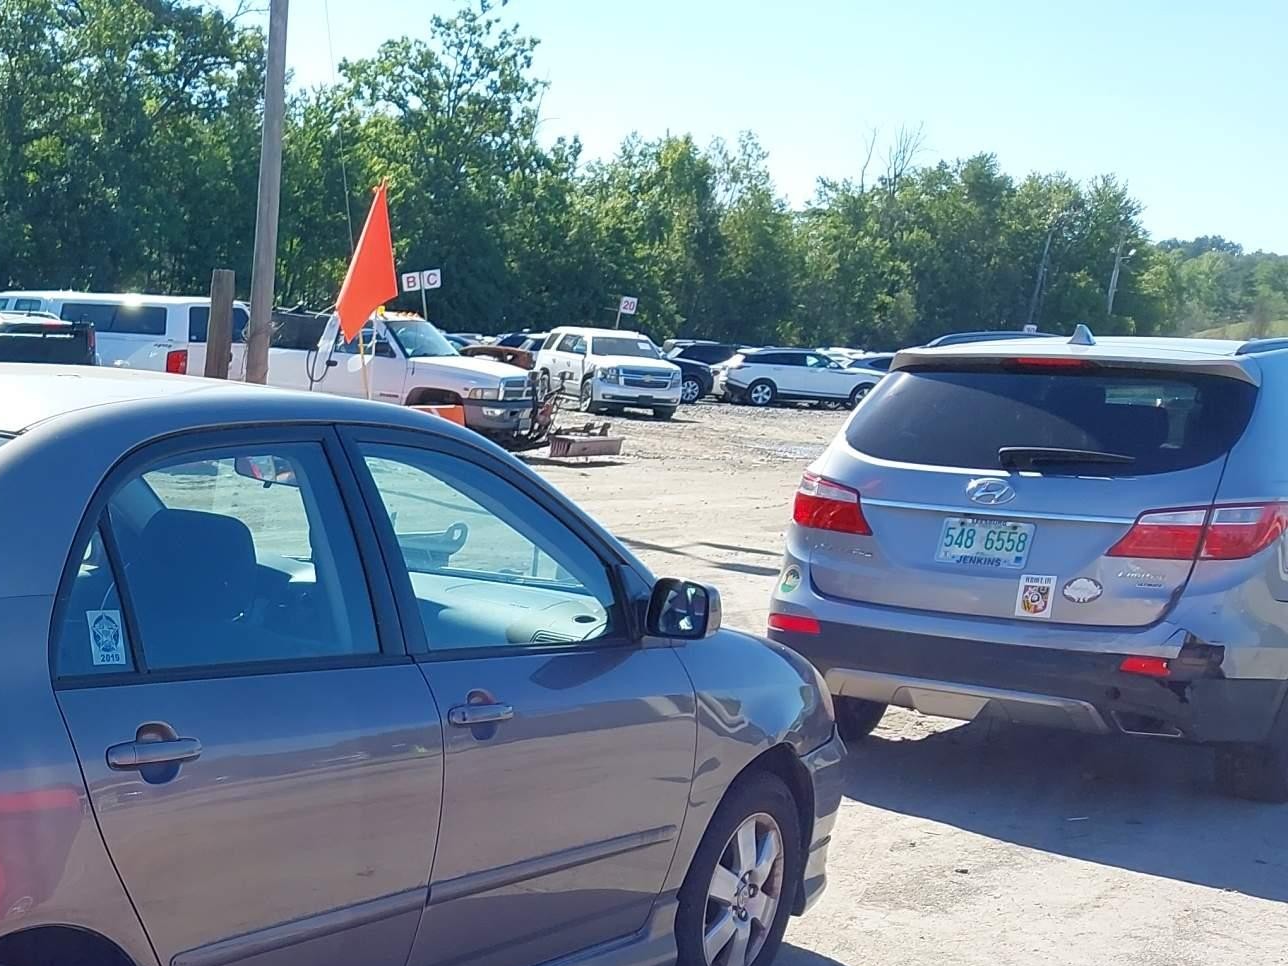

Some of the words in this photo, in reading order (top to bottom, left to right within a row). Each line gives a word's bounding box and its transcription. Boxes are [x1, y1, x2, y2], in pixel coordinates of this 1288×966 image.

[407, 276, 416, 288] B
[427, 273, 437, 285] C
[623, 300, 635, 311] 20
[944, 527, 976, 549] 548
[984, 530, 1028, 552] 6558
[956, 555, 1002, 567] JENKINS
